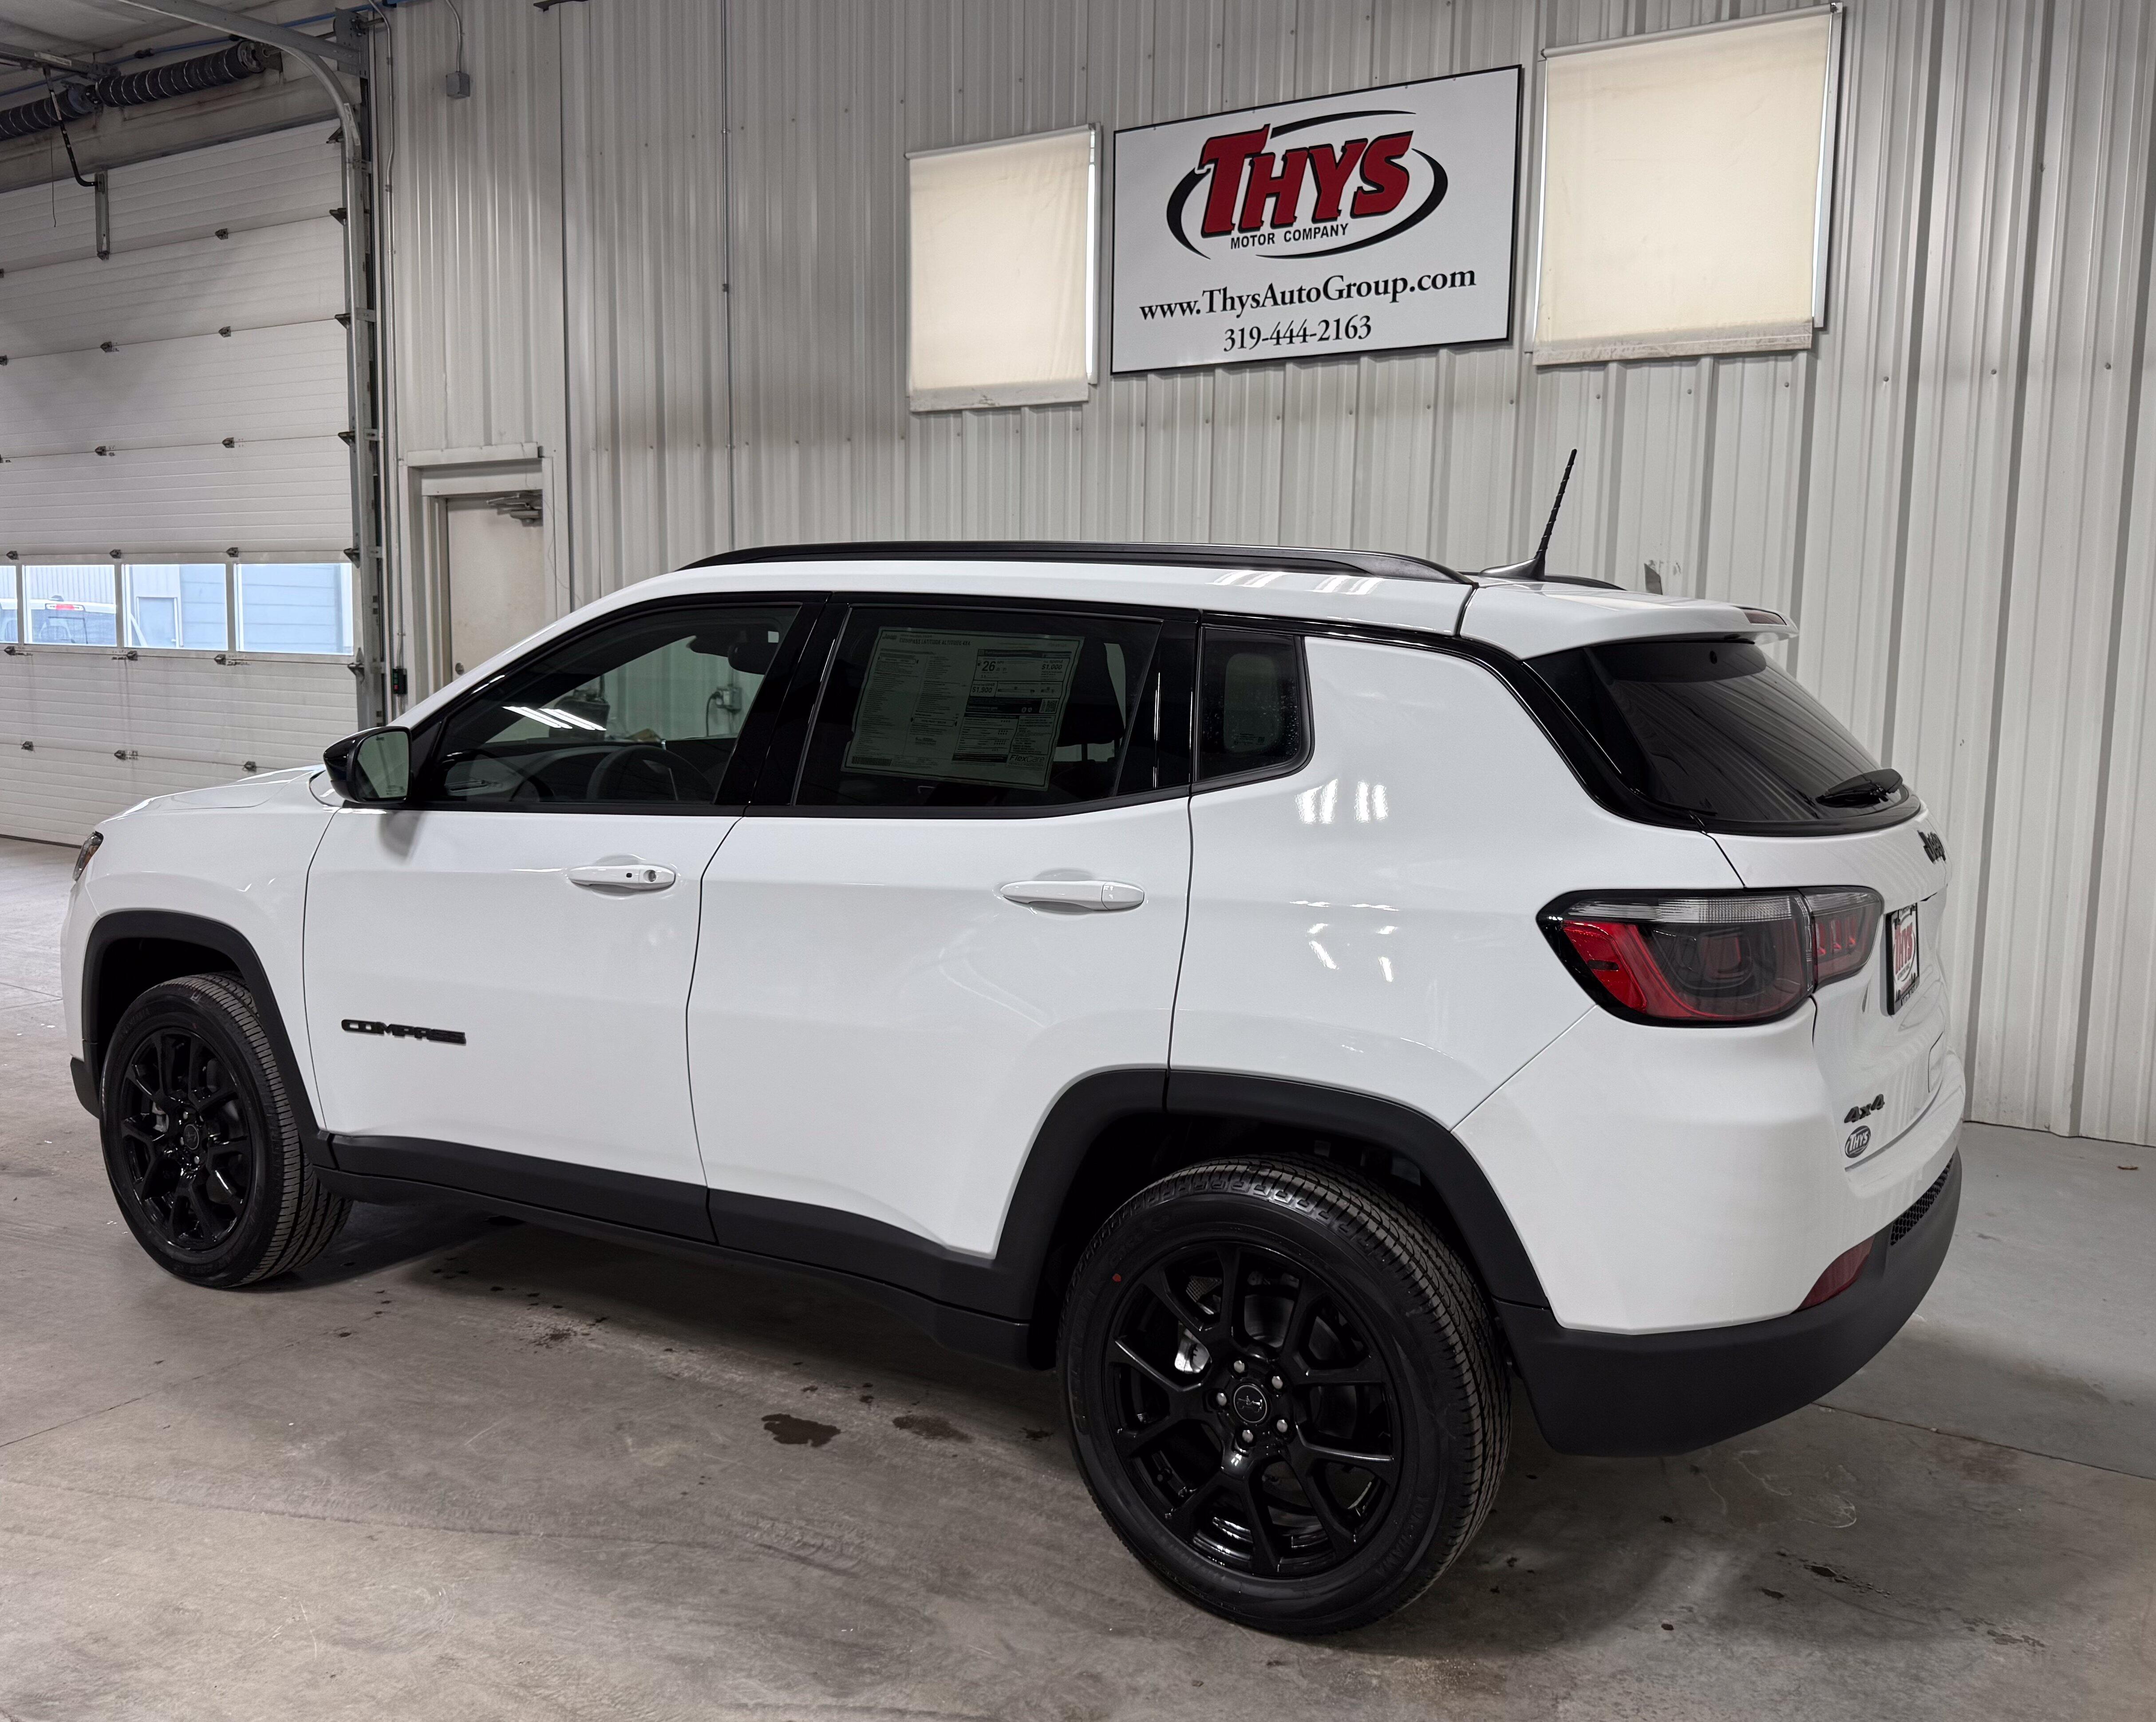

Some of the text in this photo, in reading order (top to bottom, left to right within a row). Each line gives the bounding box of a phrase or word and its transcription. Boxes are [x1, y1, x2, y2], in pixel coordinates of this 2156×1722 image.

[1195, 123, 1414, 238] THYS
[1231, 223, 1349, 250] MOTOR COMPANY
[1139, 269, 1477, 320] www.ThysAutoGroup.com
[1223, 315, 1372, 352] 319-444-2163
[982, 661, 996, 671] 26
[1894, 922, 1913, 976] THYS
[1848, 1130, 1869, 1152] THYS
